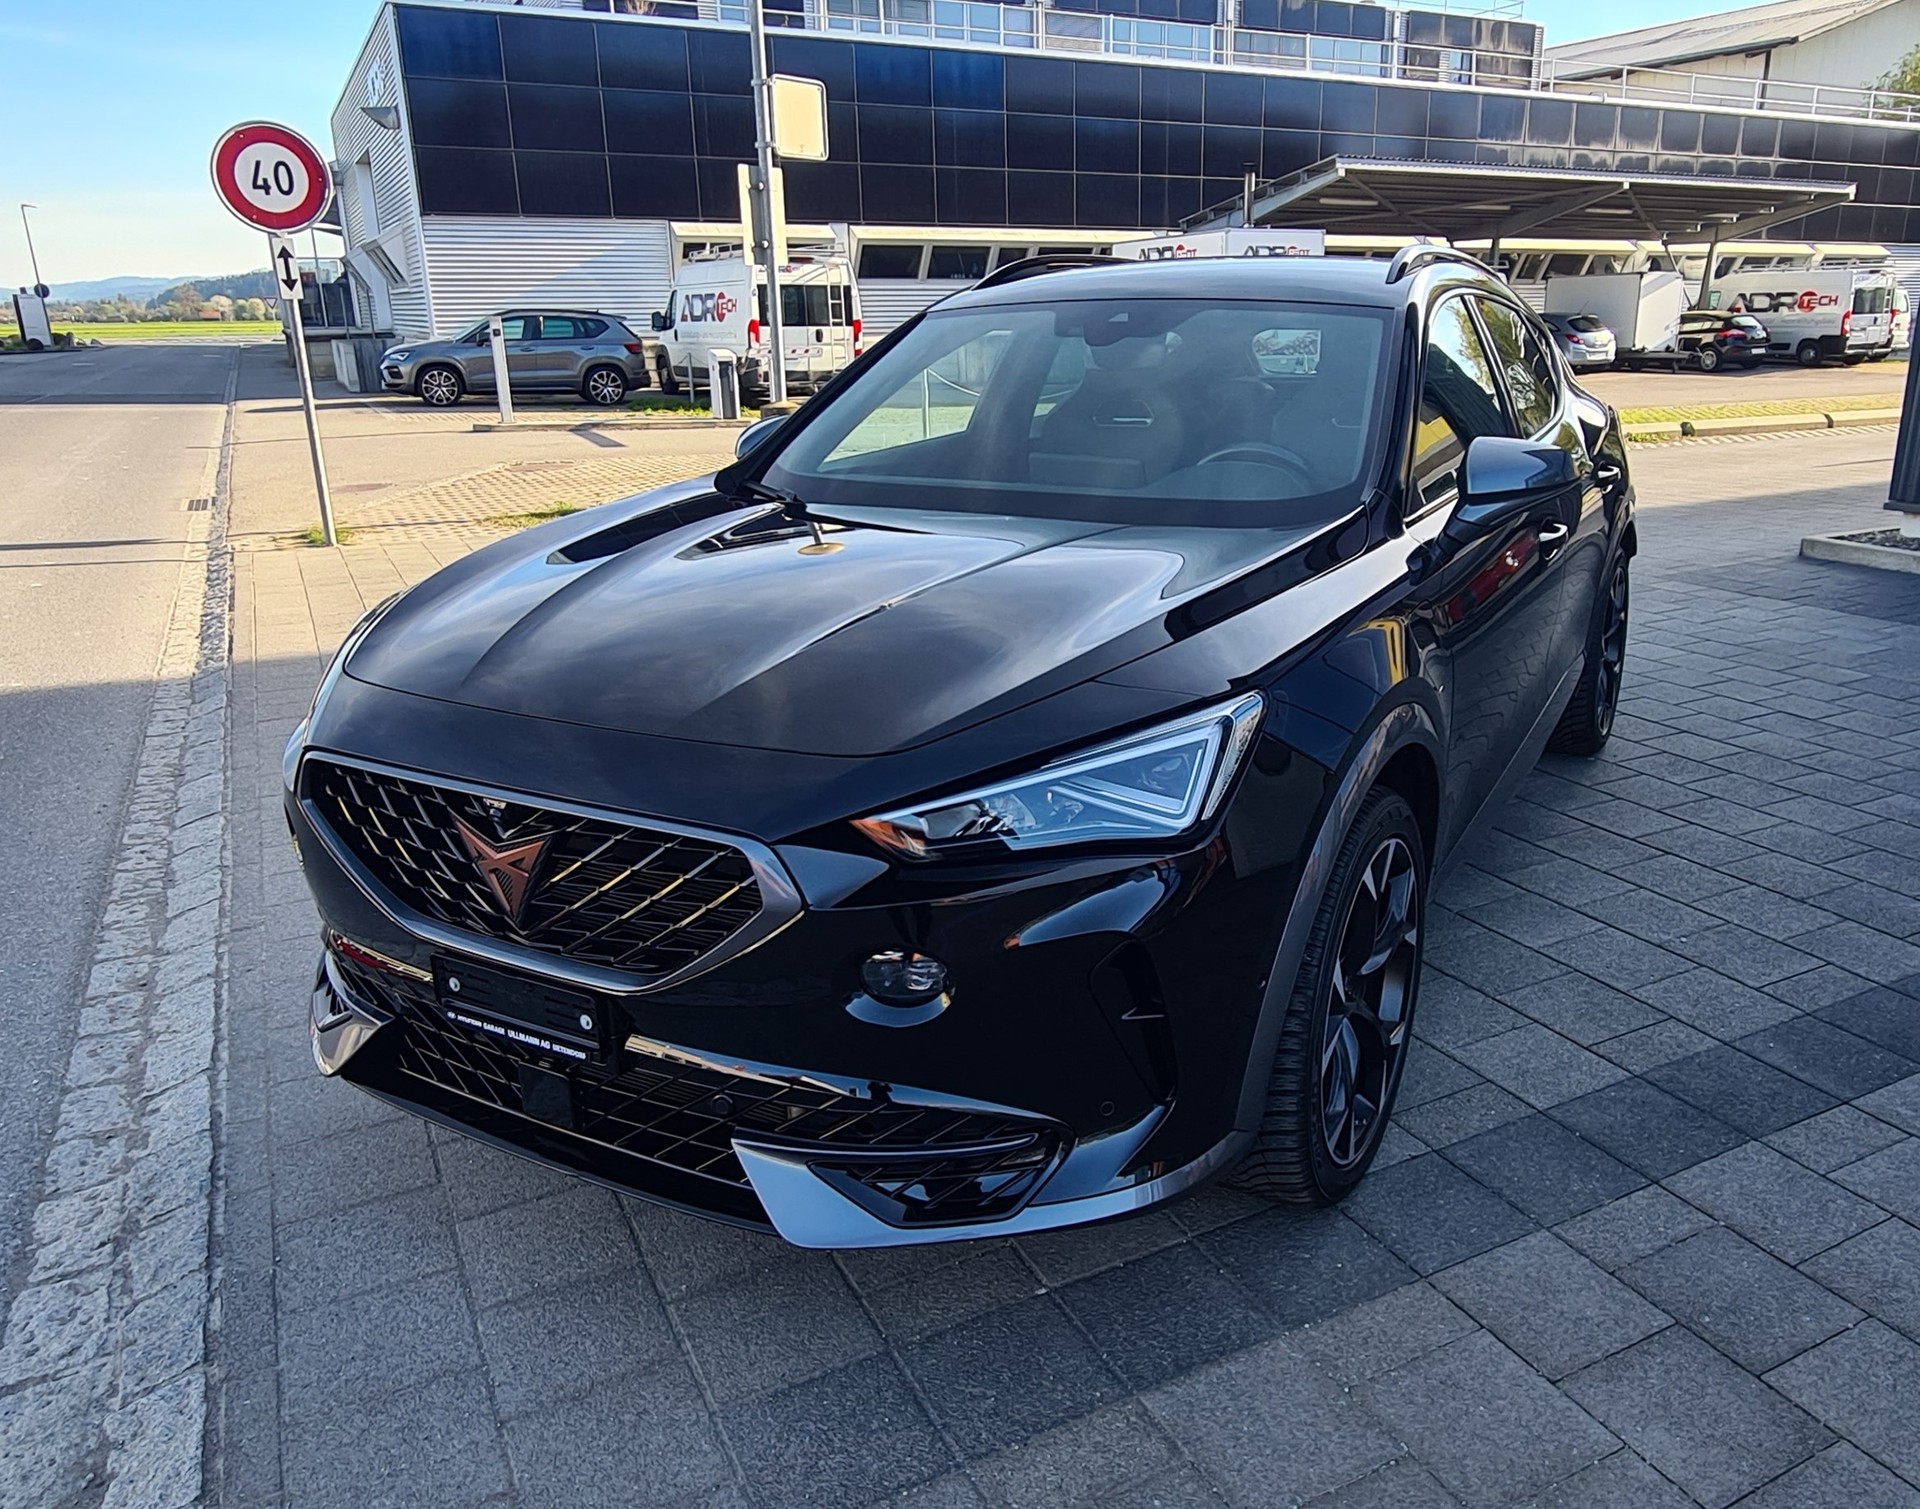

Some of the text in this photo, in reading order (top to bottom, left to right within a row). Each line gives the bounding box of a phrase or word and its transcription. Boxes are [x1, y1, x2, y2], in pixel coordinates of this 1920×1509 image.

[252, 160, 294, 196] 40
[507, 1029, 540, 1046] ULLMANN
[540, 1039, 551, 1049] AG
